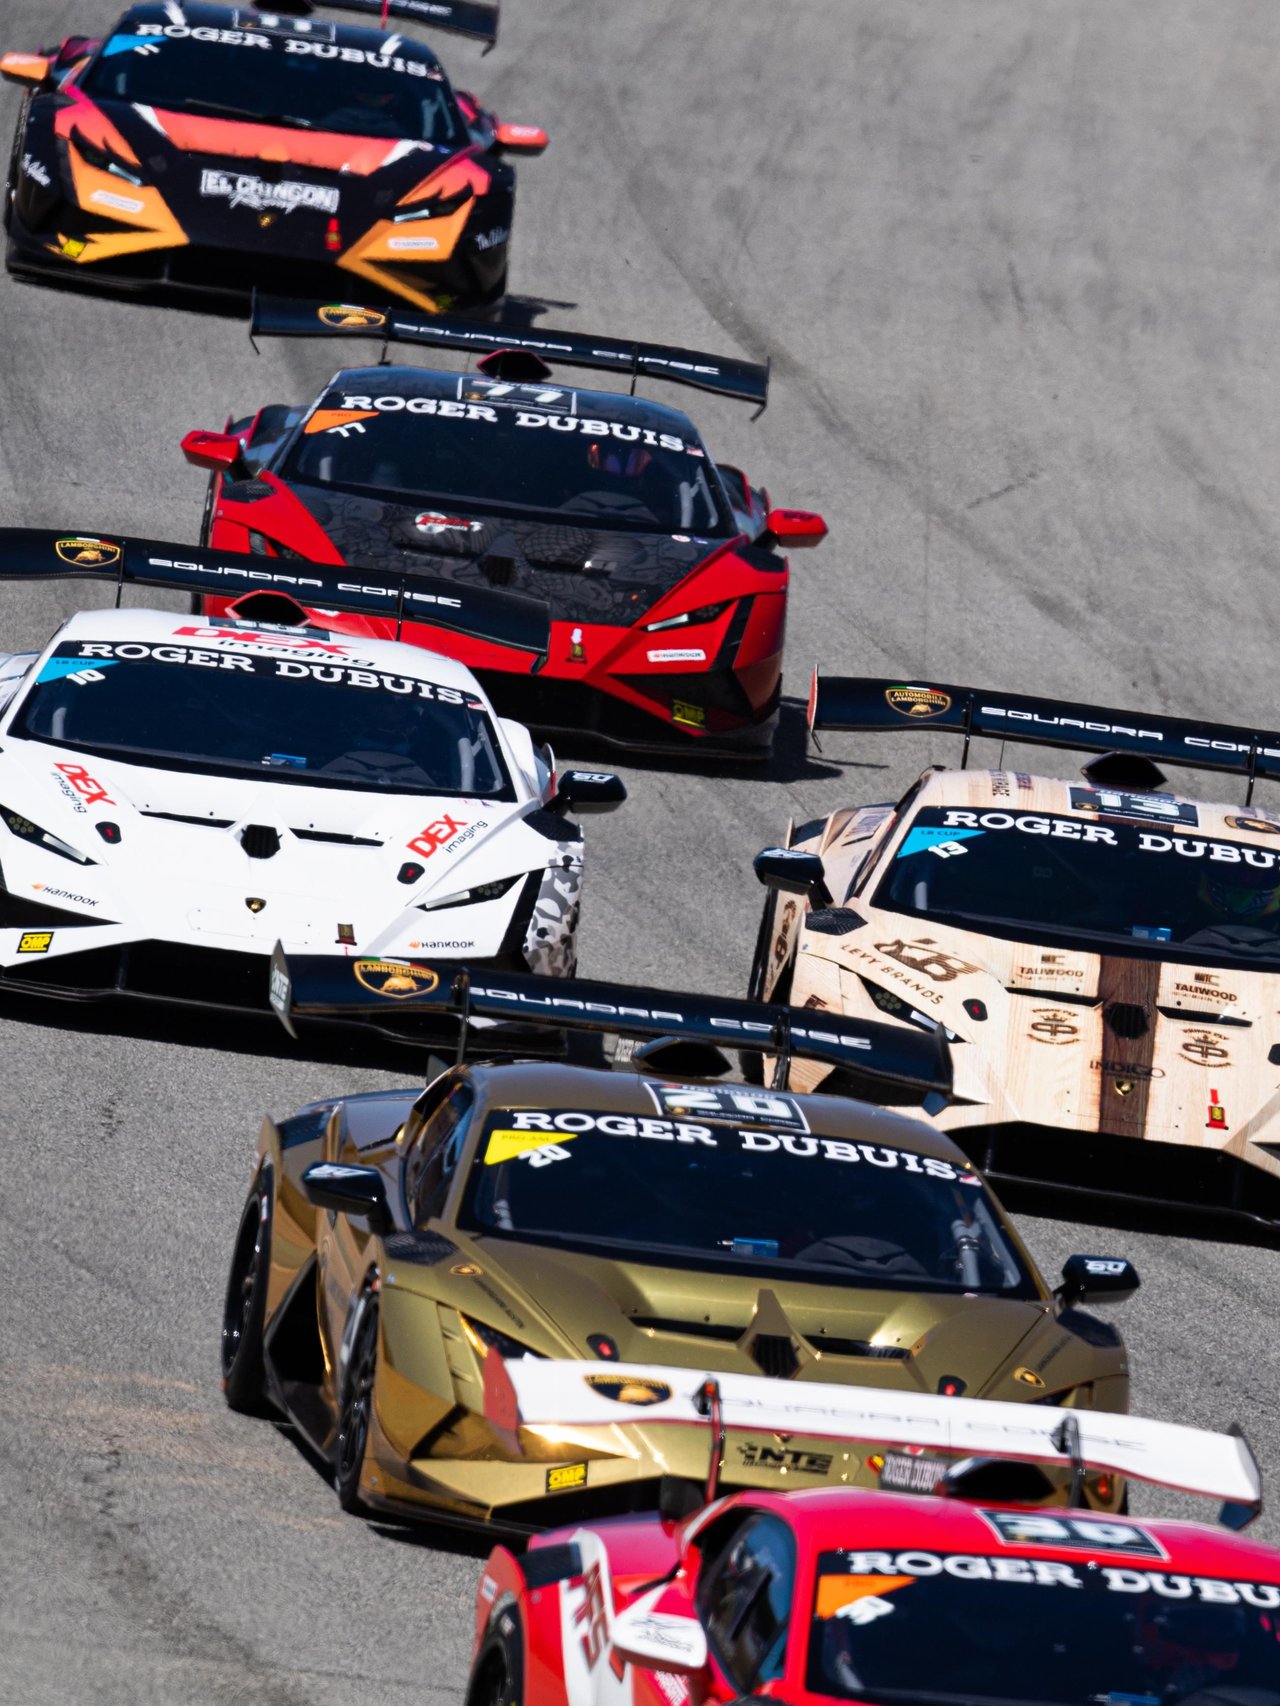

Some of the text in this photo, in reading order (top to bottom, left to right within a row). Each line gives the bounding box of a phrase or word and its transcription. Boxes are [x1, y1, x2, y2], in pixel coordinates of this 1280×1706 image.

[135, 24, 428, 78] ROGER DUBUIS
[394, 323, 573, 352] SQUADRA
[469, 381, 568, 404] 77
[342, 395, 686, 453] ROGER DUBUIS
[148, 557, 461, 609] SQUADRA CORSE
[217, 639, 376, 668] imaging
[66, 668, 106, 687] 10
[78, 642, 467, 706] ROGER DUBUIS
[980, 706, 1164, 741] SQUADRA
[51, 772, 88, 814] imaging
[53, 762, 118, 807] DEX
[405, 813, 469, 859] DEX
[442, 818, 488, 854] imaging
[943, 810, 1119, 845] ROGER
[927, 840, 969, 859] 13
[21, 936, 51, 948] OMP
[841, 943, 946, 1006] LEVY BRANDS
[469, 986, 872, 1051] SQUADRA CORSE
[512, 1112, 957, 1181] ROGER DUBUIS
[518, 1143, 573, 1170] 20
[548, 1464, 586, 1483] OMP
[847, 1551, 1085, 1589] ROGER
